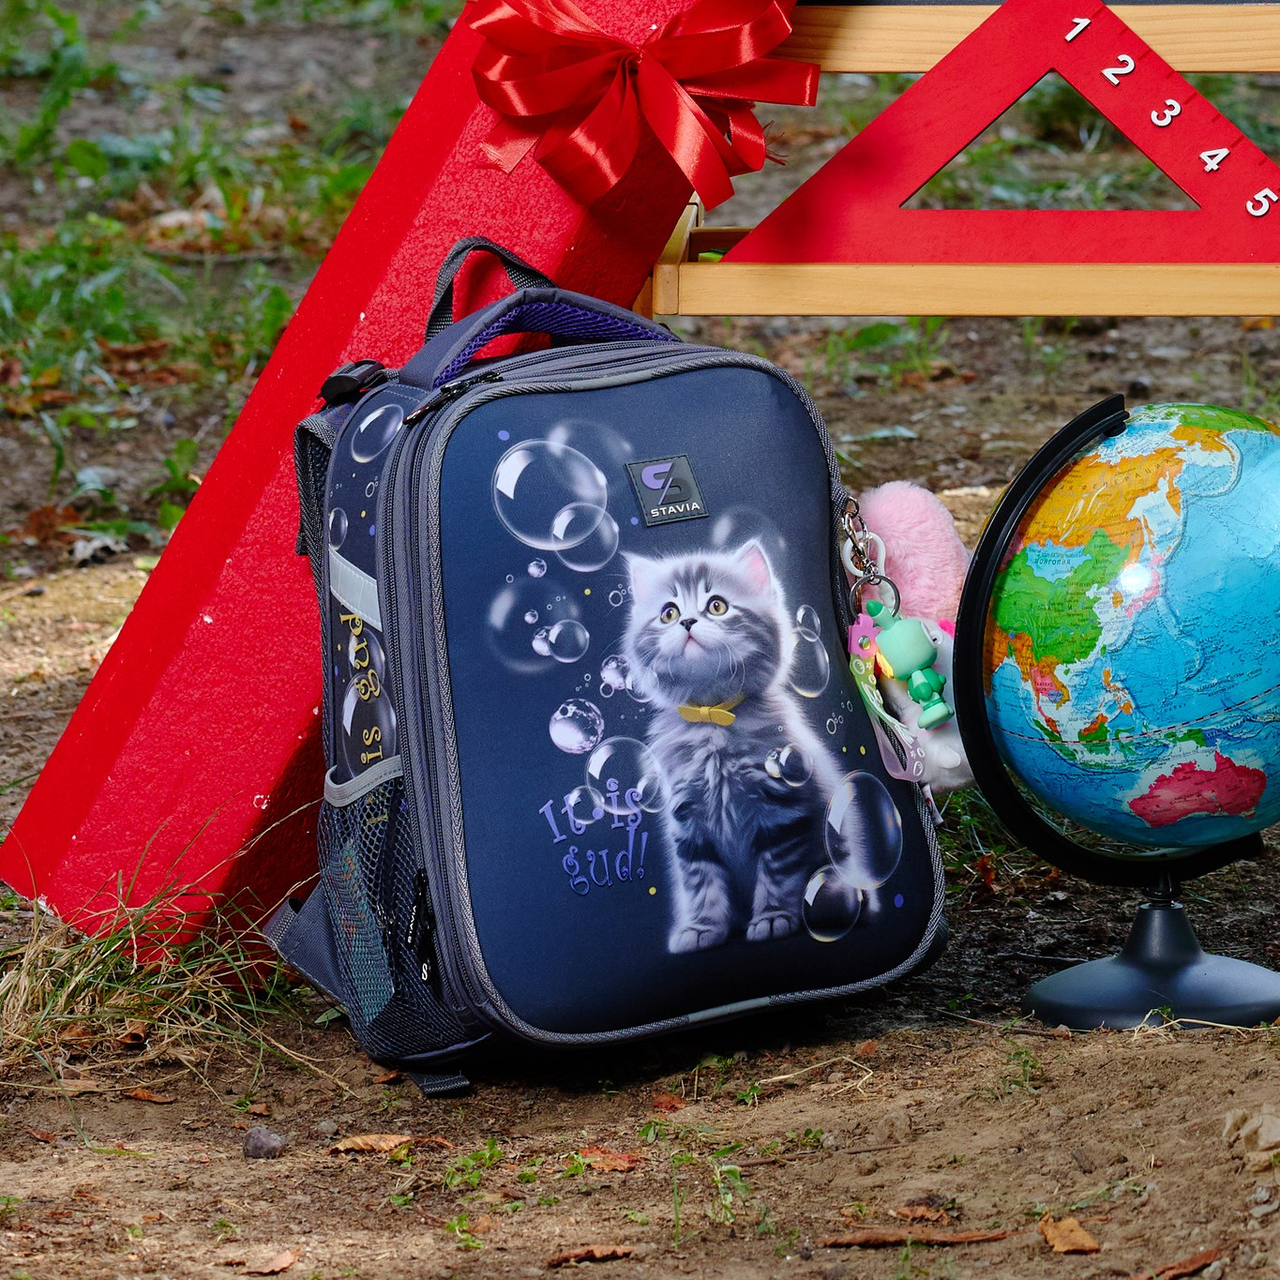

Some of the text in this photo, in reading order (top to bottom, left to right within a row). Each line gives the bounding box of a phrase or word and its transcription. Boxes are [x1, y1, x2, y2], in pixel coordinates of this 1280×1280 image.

[1065, 17, 1091, 42] 1
[1101, 53, 1136, 86] 2
[1149, 99, 1182, 128] 3
[1199, 147, 1232, 174] 4
[1245, 187, 1279, 218] 5
[650, 502, 701, 518] STAVIA
[538, 777, 643, 844] It is
[561, 826, 649, 896] gud!
